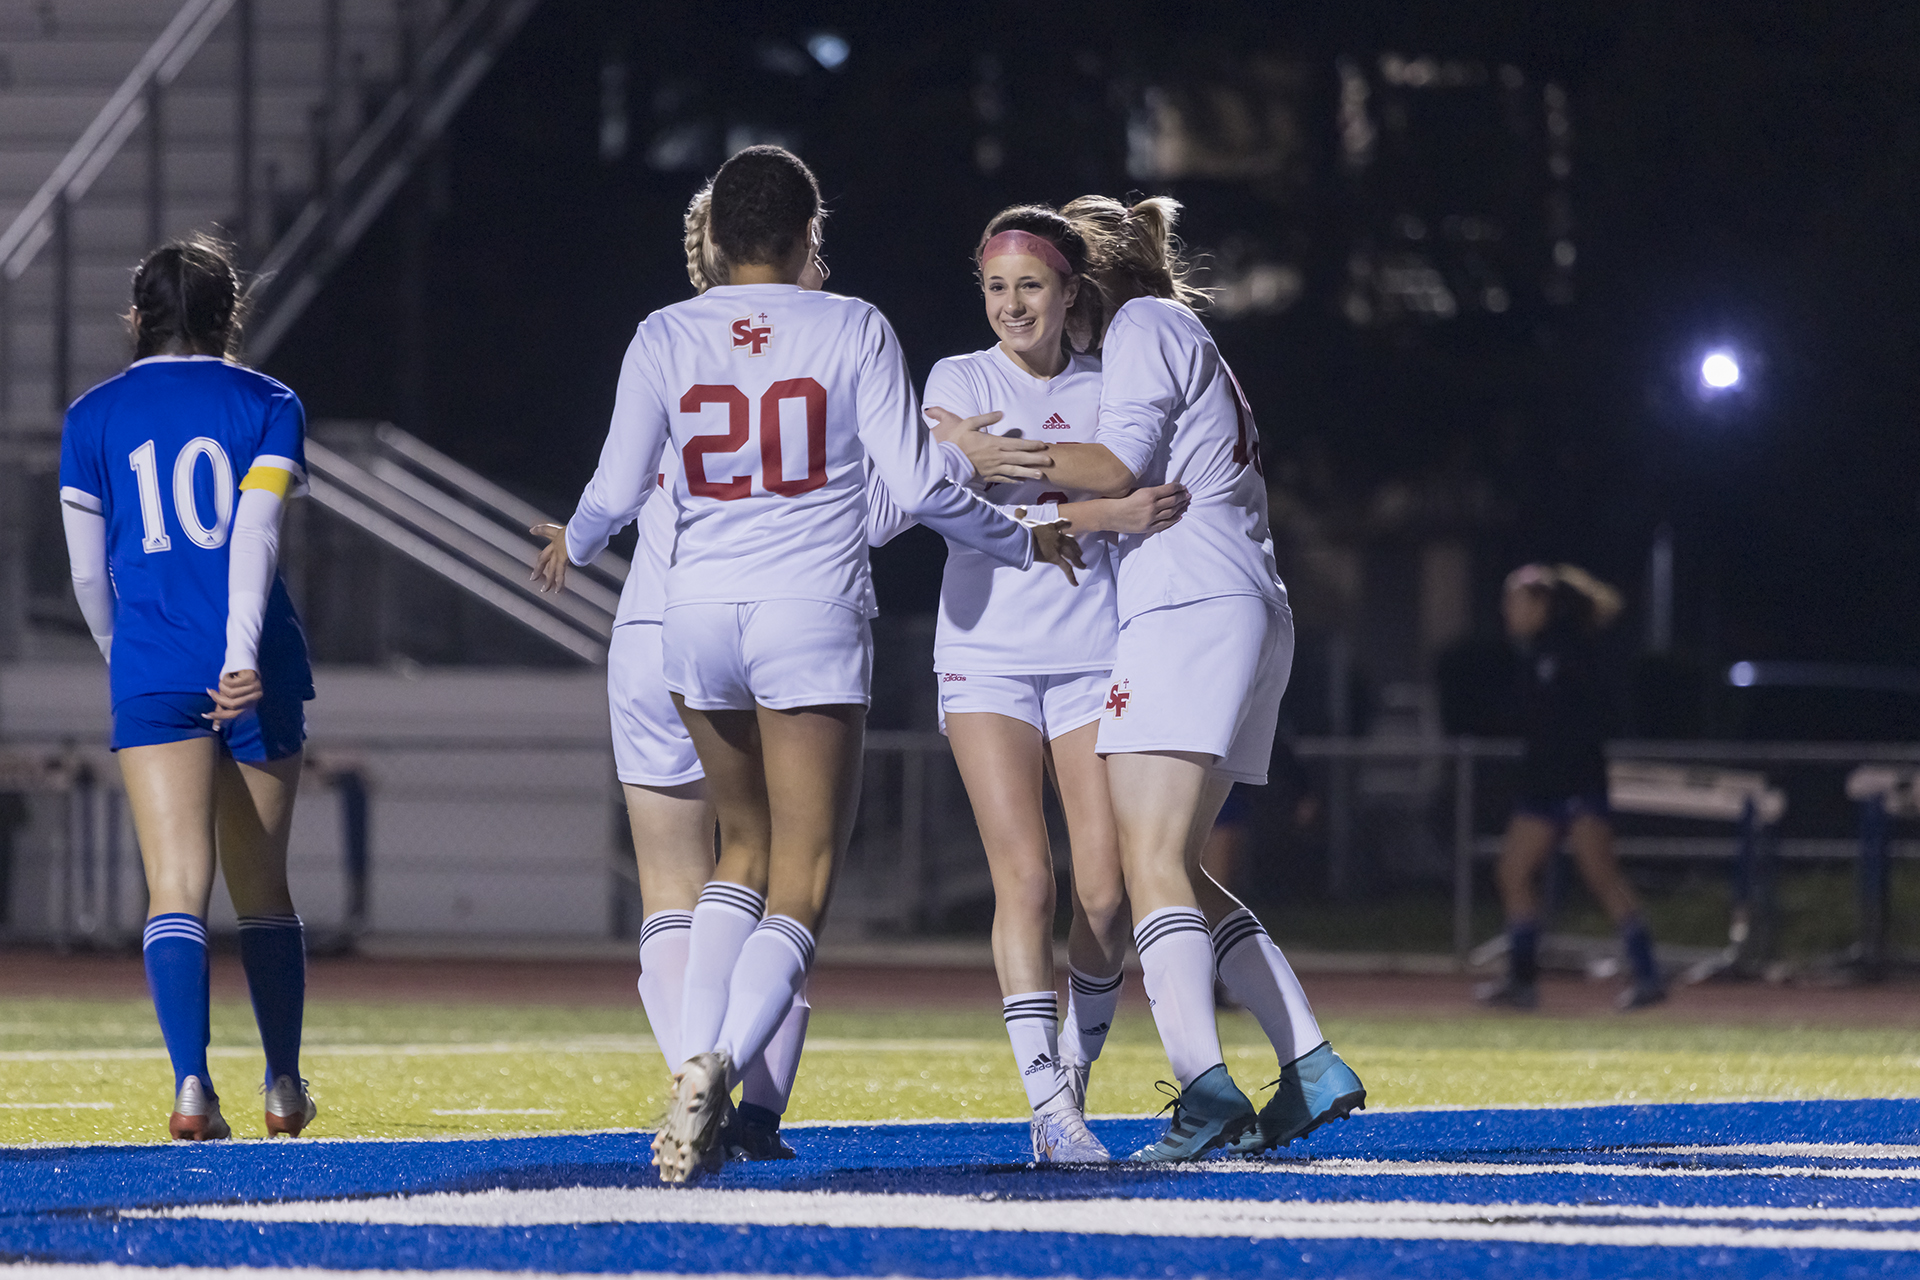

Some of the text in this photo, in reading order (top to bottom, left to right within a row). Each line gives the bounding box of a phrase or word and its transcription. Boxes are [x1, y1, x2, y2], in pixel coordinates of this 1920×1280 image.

[730, 316, 773, 356] SF
[679, 377, 829, 501] 20
[1042, 422, 1071, 430] adidas
[129, 436, 234, 554] 10
[1105, 682, 1131, 718] SF
